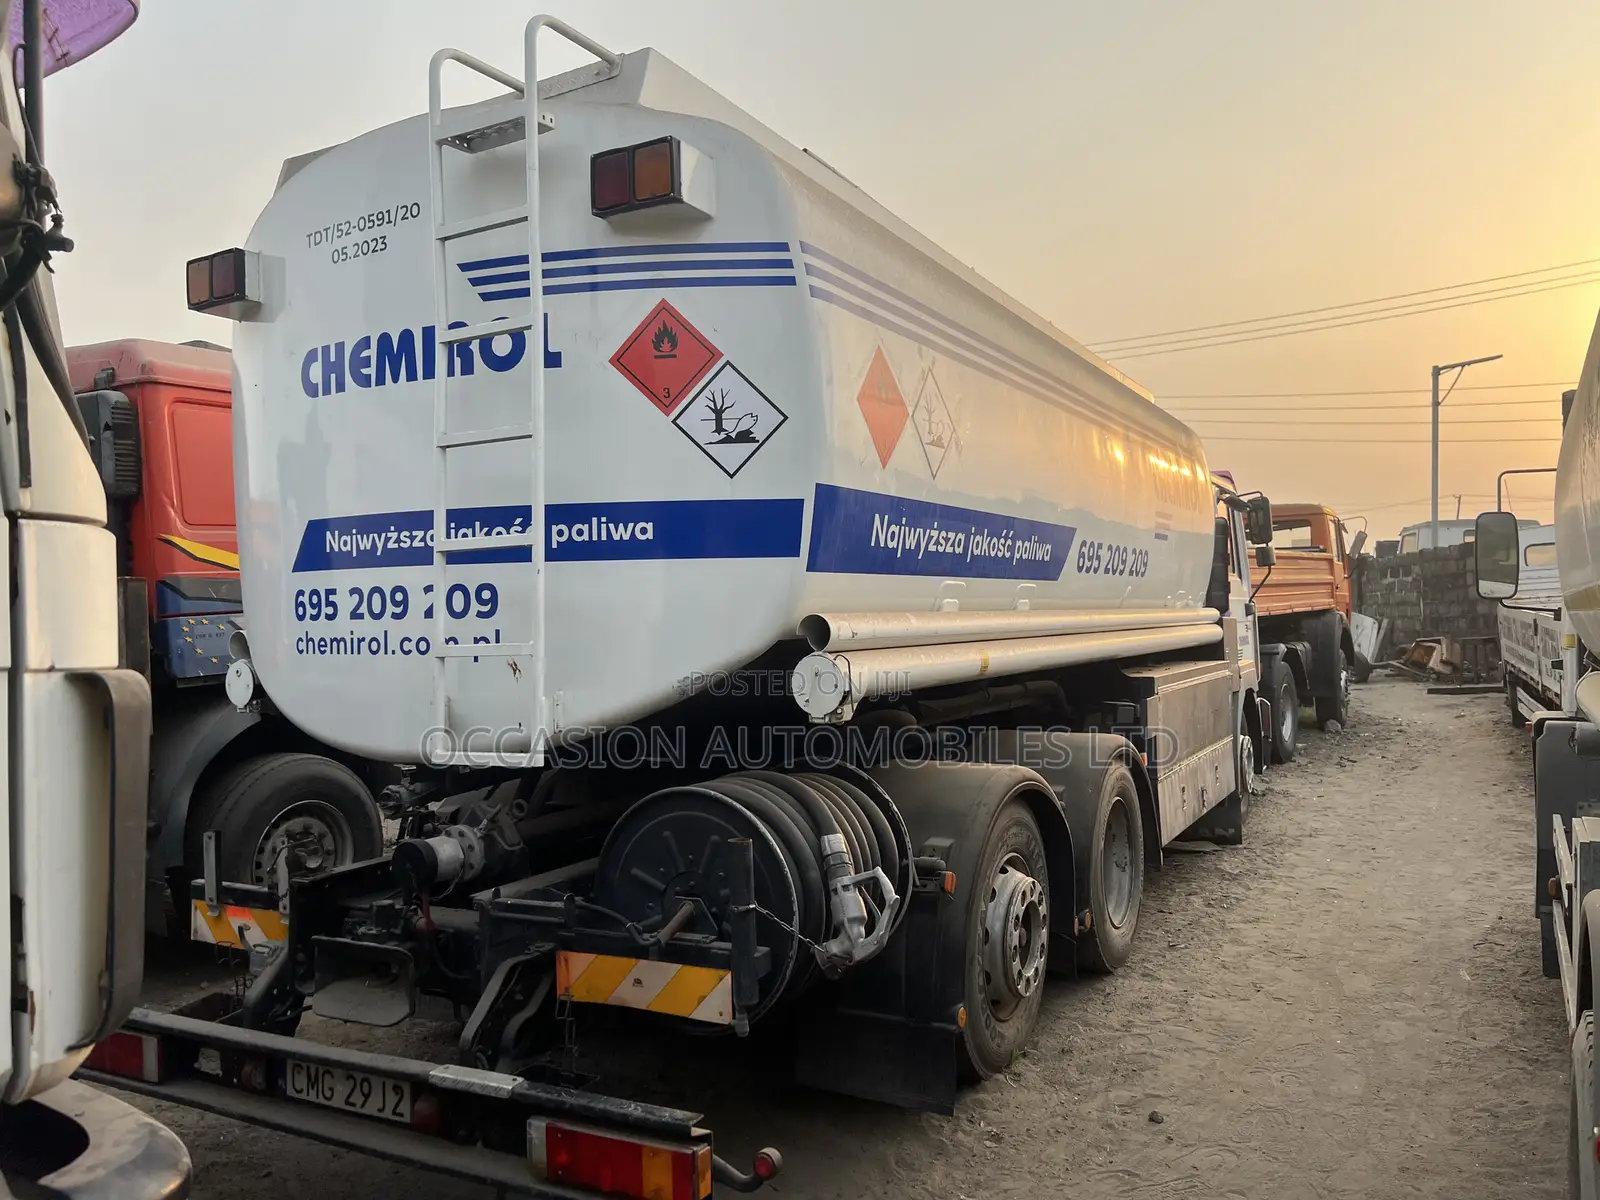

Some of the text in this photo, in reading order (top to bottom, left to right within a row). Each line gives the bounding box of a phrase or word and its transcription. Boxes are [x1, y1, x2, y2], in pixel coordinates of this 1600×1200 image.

[306, 202, 421, 249] TDT/52-0591/20
[331, 235, 388, 264] 05.2023
[301, 312, 562, 398] CHEMIROL
[663, 388, 671, 399] 3
[551, 517, 654, 549] paliwa
[871, 513, 1052, 565] Najwyższa jakość paliwa
[1077, 539, 1149, 578] 695 209 209
[294, 587, 339, 622] 695
[348, 585, 410, 621] 209
[291, 1062, 334, 1101] CMG
